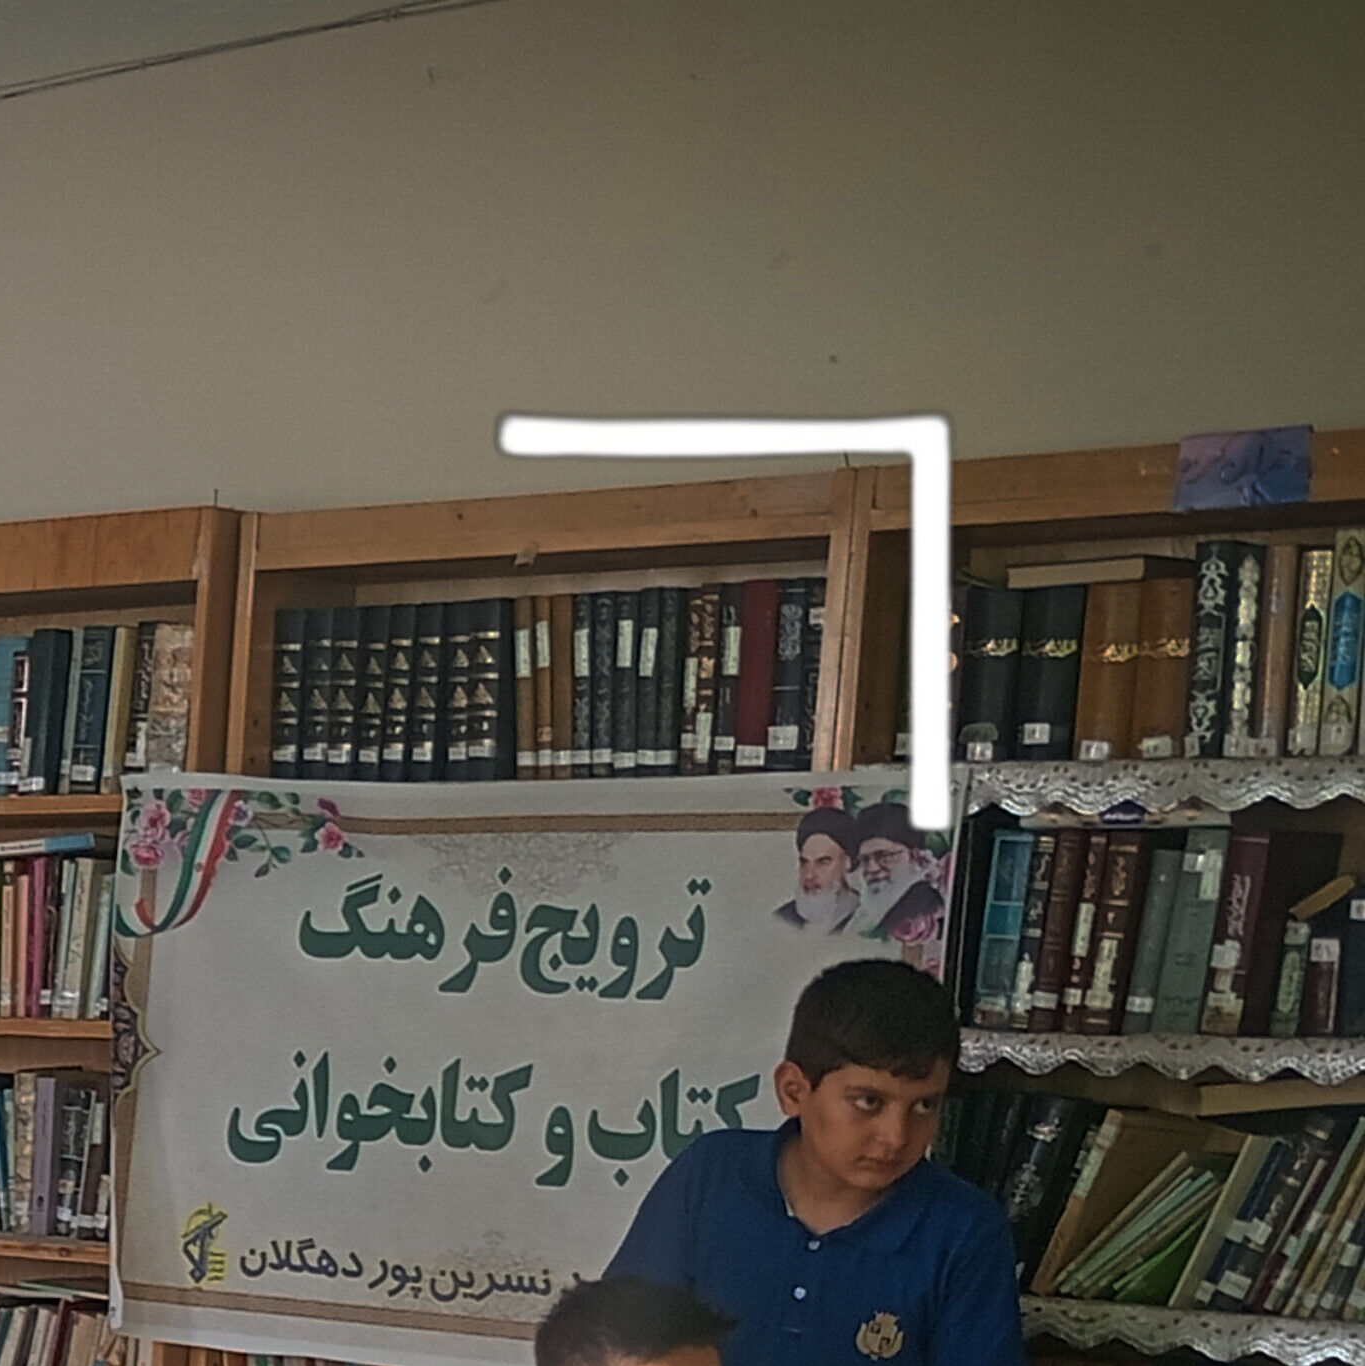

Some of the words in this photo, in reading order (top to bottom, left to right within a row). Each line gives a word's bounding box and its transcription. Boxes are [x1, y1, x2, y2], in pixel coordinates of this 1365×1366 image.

[299, 866, 518, 994] فرهنگ
[519, 878, 711, 1000] ترویج
[227, 1050, 534, 1173] کتابخوانی
[535, 1106, 575, 1187] و
[239, 1238, 365, 1278] دهگلان
[367, 1259, 424, 1299] پور
[429, 1268, 553, 1303] نسرین
